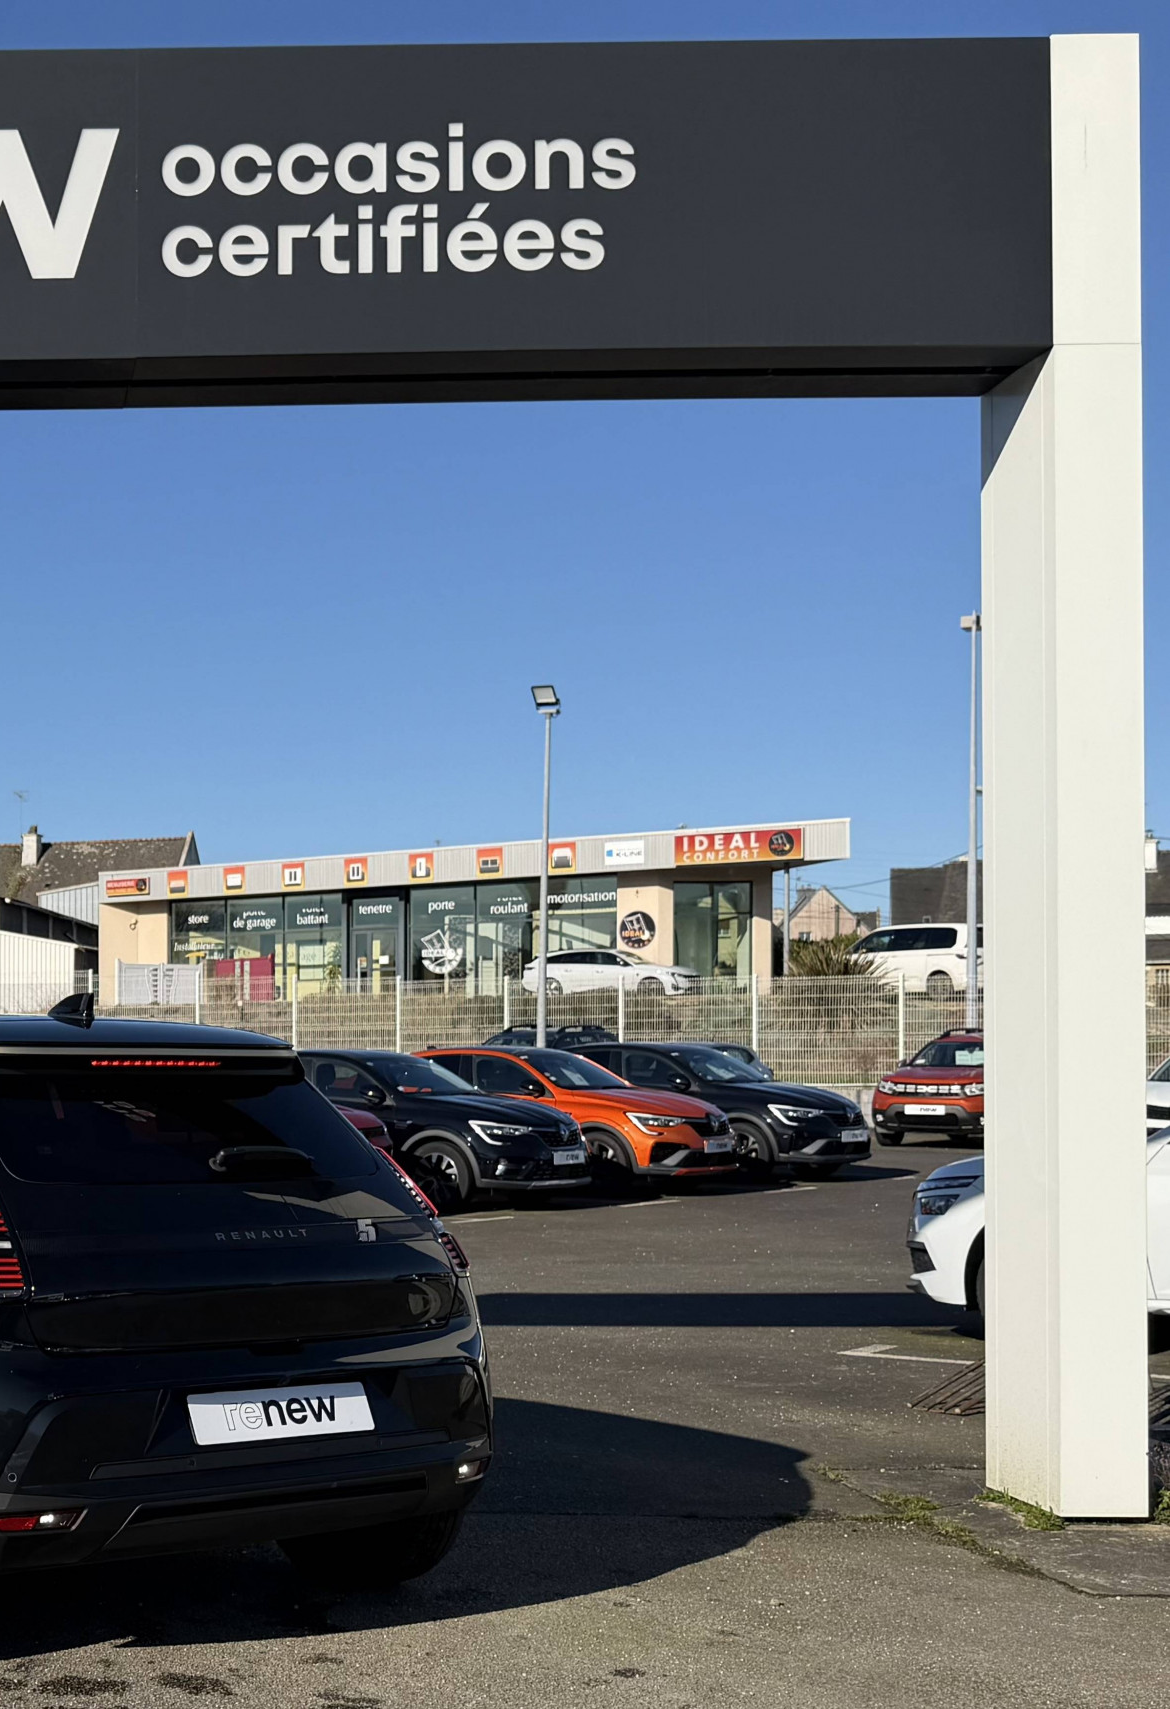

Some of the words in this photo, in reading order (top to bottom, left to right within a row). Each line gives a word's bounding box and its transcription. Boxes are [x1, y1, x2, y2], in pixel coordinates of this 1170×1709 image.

[161, 122, 637, 197] occasions
[161, 202, 606, 278] certifiées
[682, 832, 760, 852] IDEAL
[682, 849, 760, 863] CONFORT
[547, 891, 617, 904] motorisation
[428, 900, 456, 914] porte
[490, 901, 529, 915] roulant
[187, 915, 209, 925] store
[233, 916, 245, 929] de
[246, 918, 277, 931] garage
[296, 913, 329, 925] battant
[215, 1228, 308, 1241] RENAULT
[222, 1395, 337, 1431] renew
